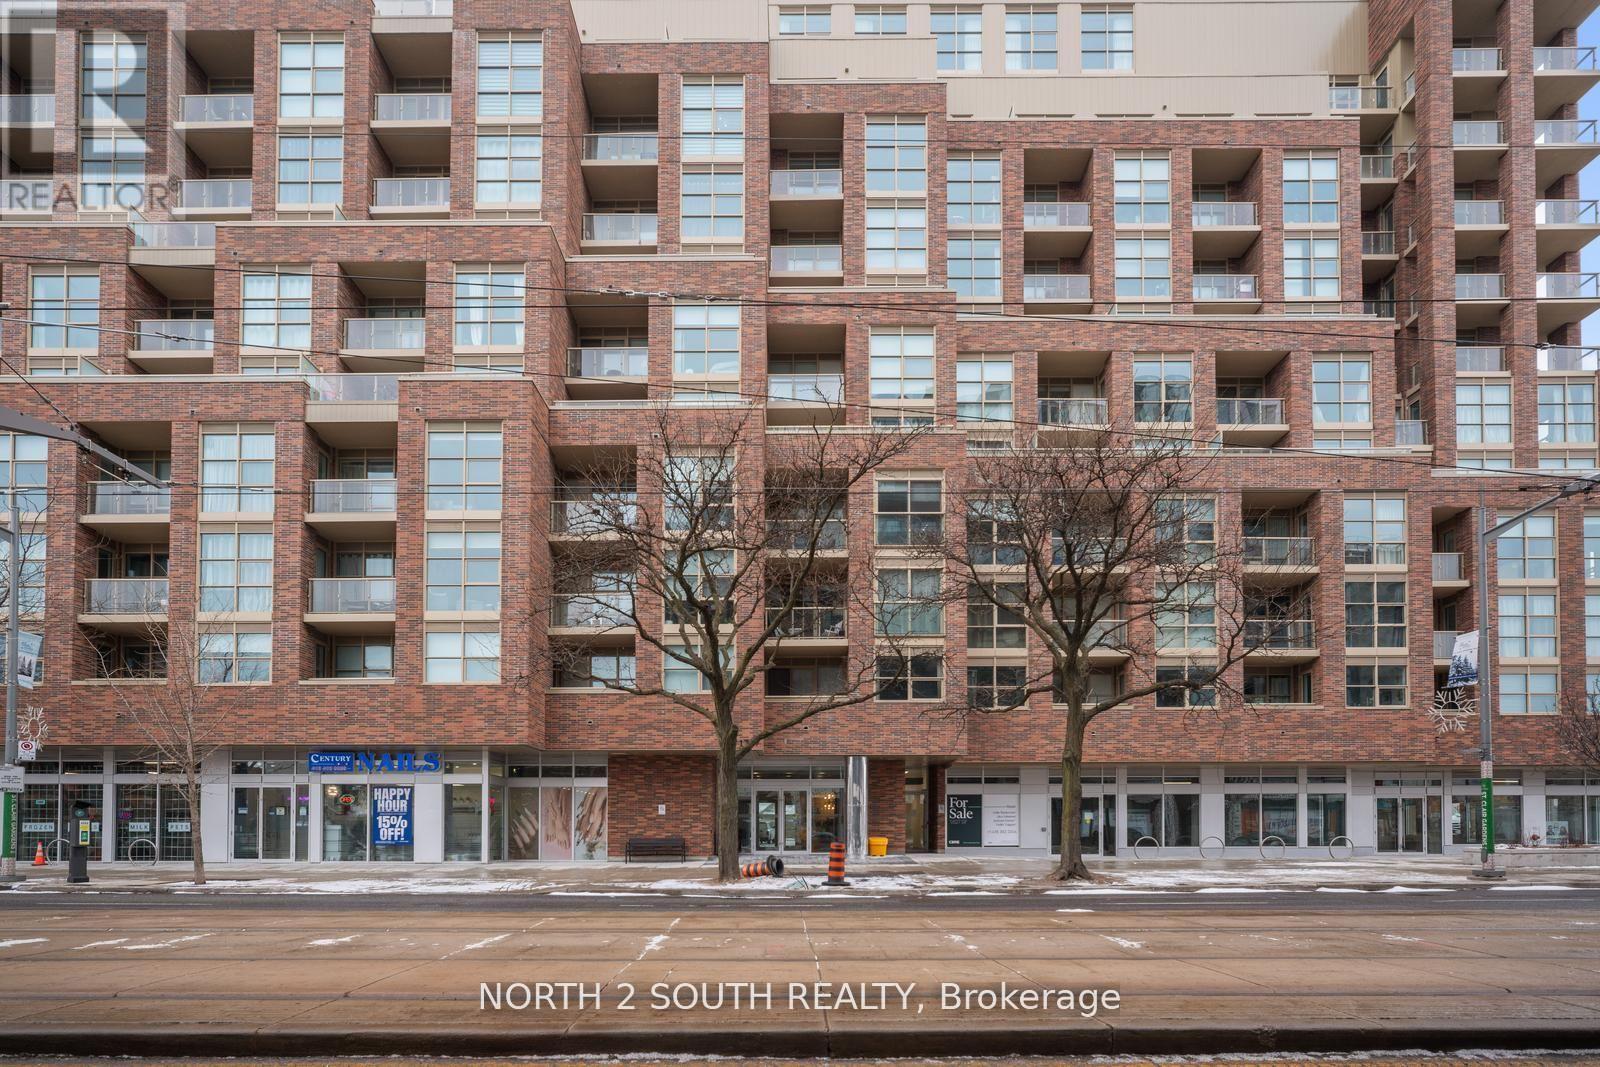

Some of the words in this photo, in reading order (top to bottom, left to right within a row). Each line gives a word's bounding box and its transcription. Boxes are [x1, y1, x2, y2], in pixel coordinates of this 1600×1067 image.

[358, 752, 441, 772] NAILS
[374, 788, 411, 800] HAPPY
[377, 800, 408, 812] HOUR
[949, 797, 969, 808] For
[949, 808, 974, 819] Sale
[376, 816, 408, 829] 15%
[380, 828, 405, 841] OFF!
